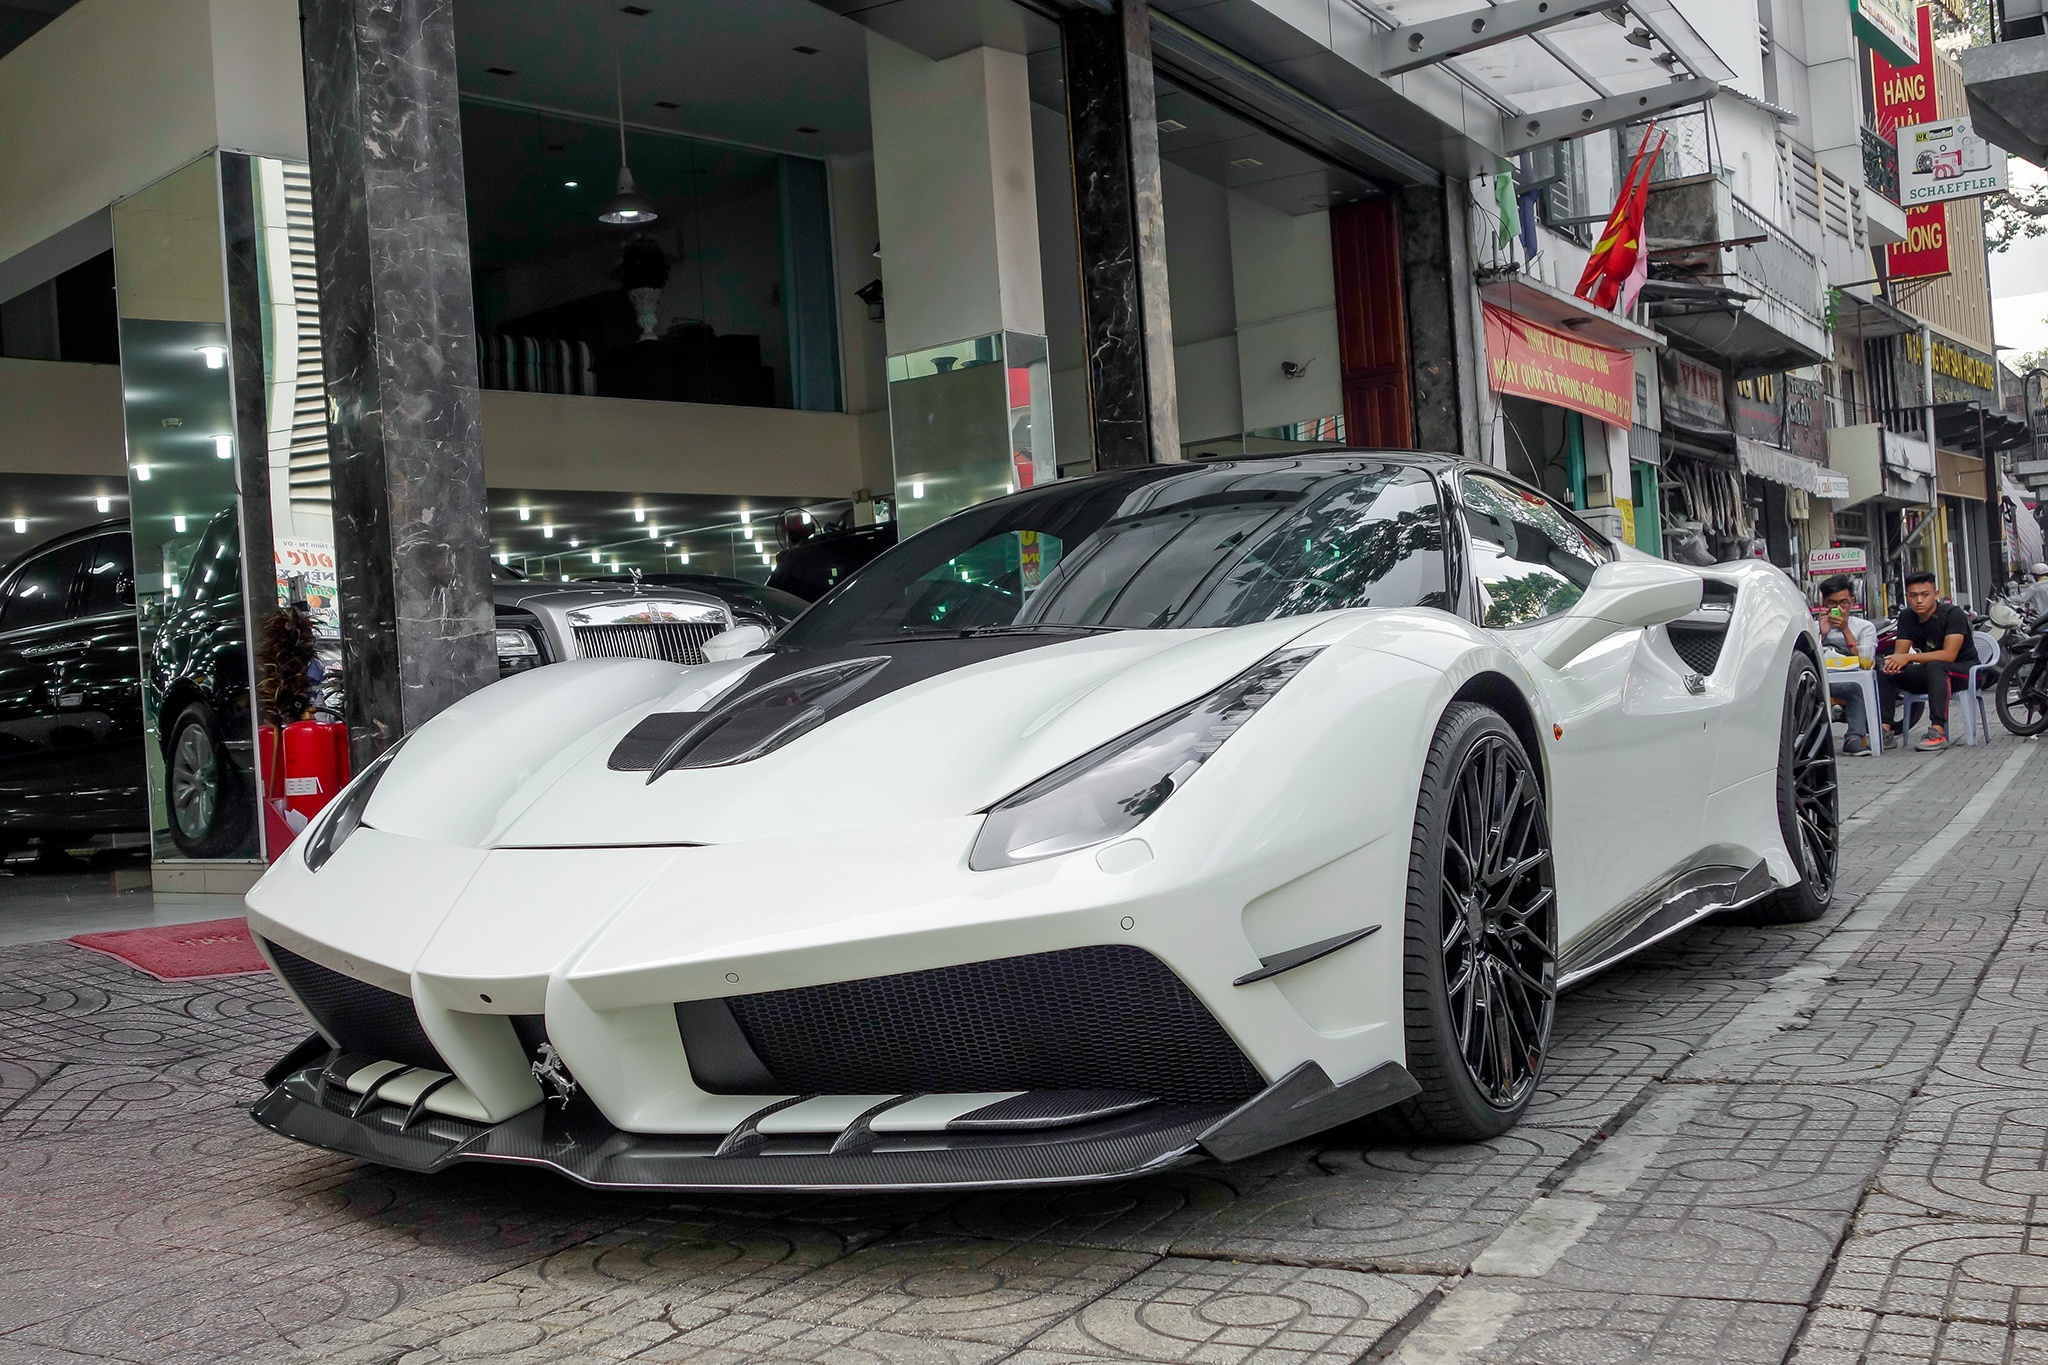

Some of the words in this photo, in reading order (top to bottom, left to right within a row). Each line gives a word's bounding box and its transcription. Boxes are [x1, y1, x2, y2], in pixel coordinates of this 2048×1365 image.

[1883, 72, 1926, 107] HÀNG
[1910, 177, 1997, 199] SCHAEFFLER
[1520, 359, 1546, 392] QUỐC
[1543, 363, 1559, 394] TẾ
[1810, 550, 1861, 562] Lotusviet
